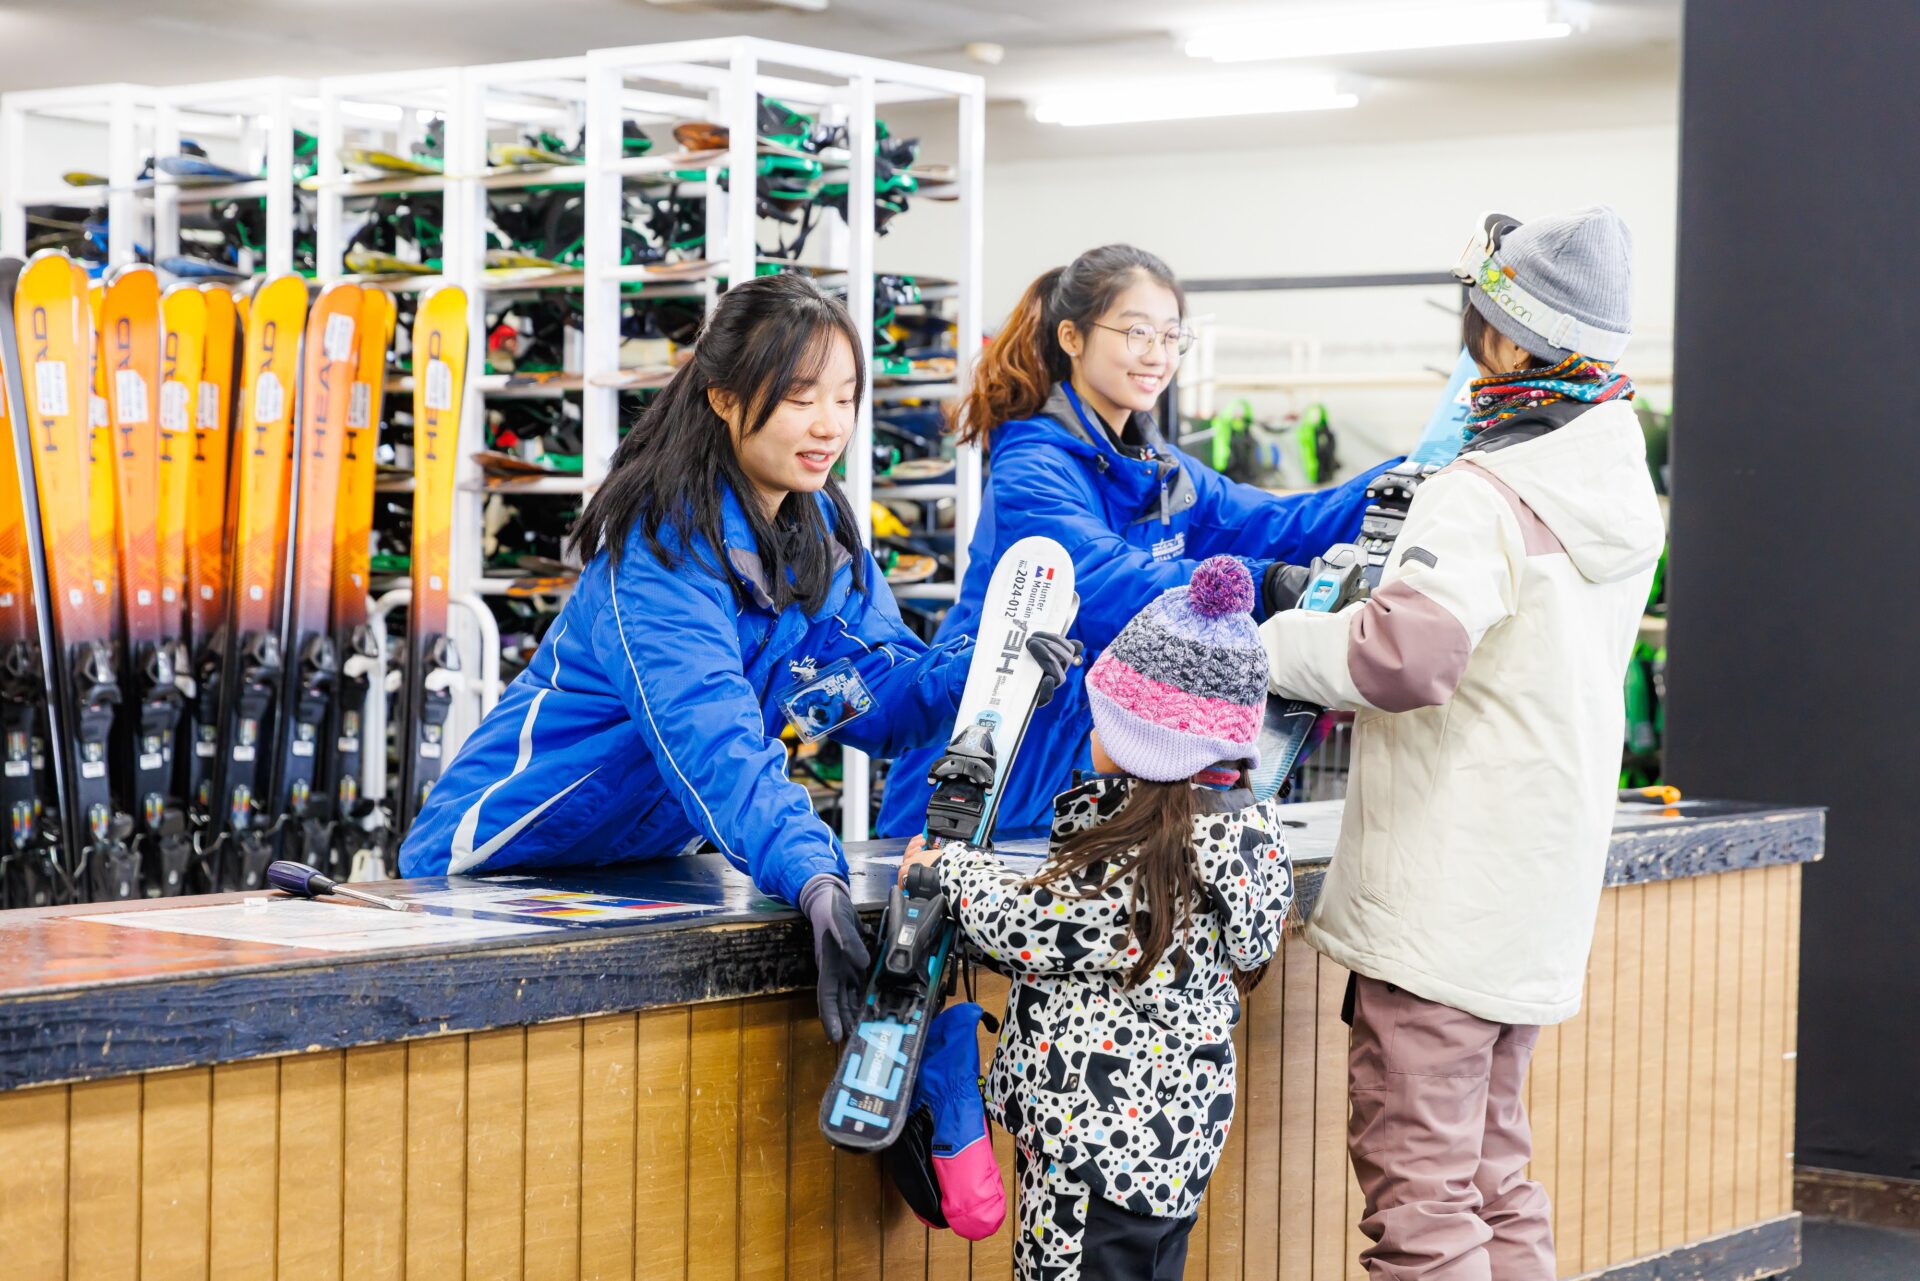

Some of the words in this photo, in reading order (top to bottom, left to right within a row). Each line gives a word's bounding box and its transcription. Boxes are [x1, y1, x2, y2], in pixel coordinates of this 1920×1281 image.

[1499, 293, 1532, 323] anon
[313, 335, 334, 458] HEA
[1004, 569, 1028, 618] 2024-012
[1023, 580, 1042, 619] Mountain
[1036, 581, 1052, 612] Hunter
[995, 618, 1028, 675] HEA
[828, 1011, 923, 1129] TEA
